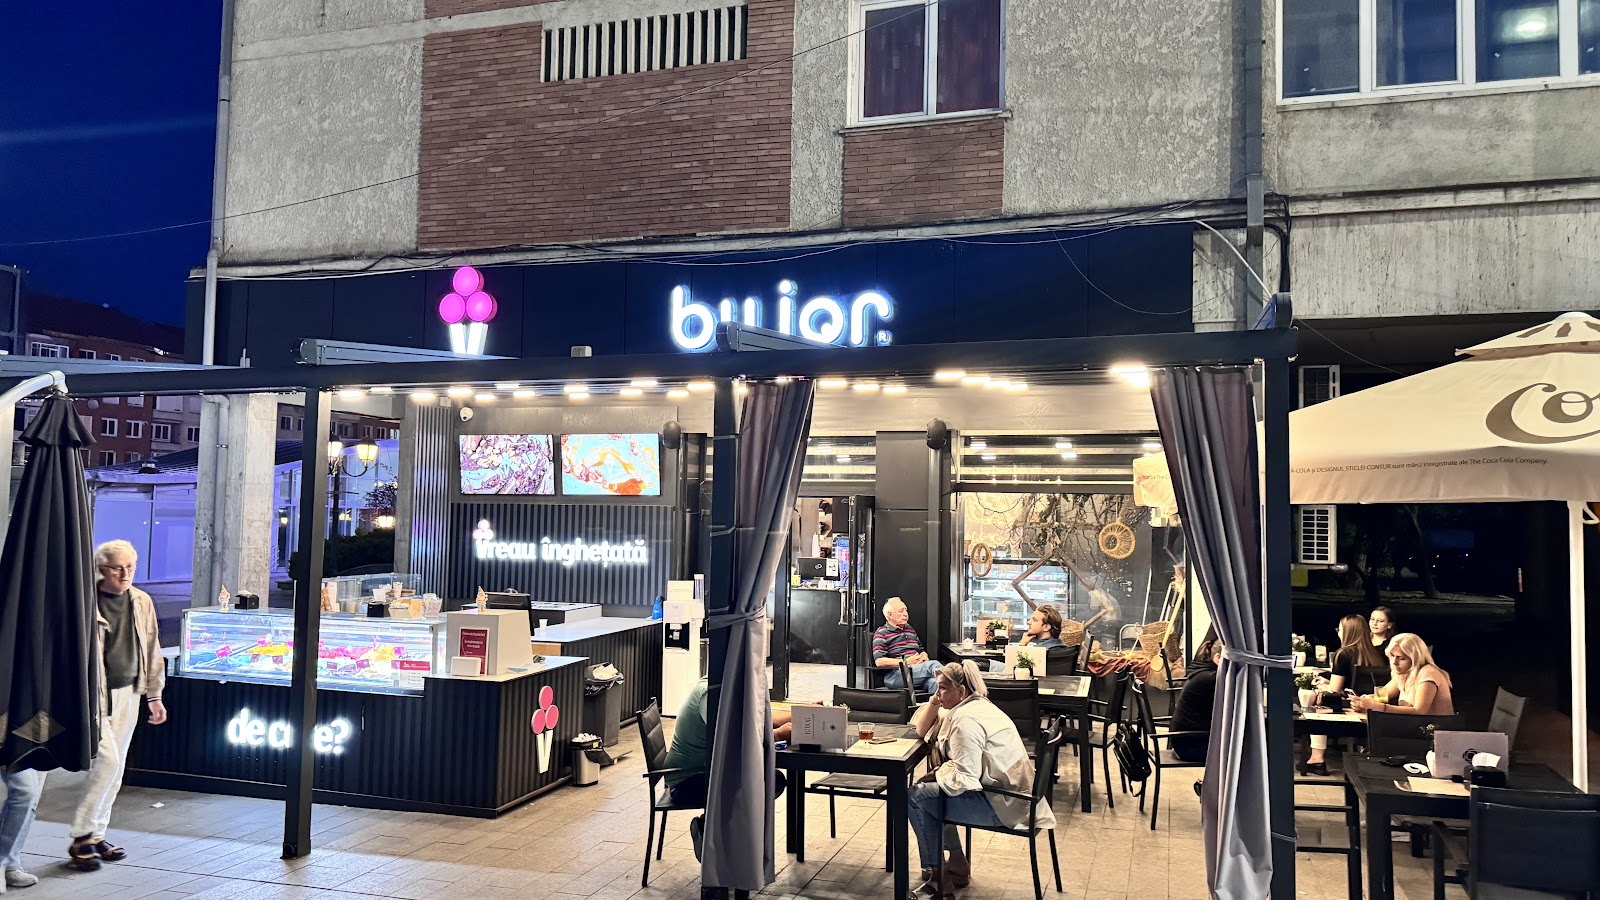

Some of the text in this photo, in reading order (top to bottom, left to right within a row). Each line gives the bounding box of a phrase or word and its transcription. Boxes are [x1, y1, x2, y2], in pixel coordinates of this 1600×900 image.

[1485, 382, 1600, 444] Co
[1366, 463, 1392, 471] CONTUR
[475, 536, 648, 568] Vreau înghețată
[226, 706, 266, 746] de
